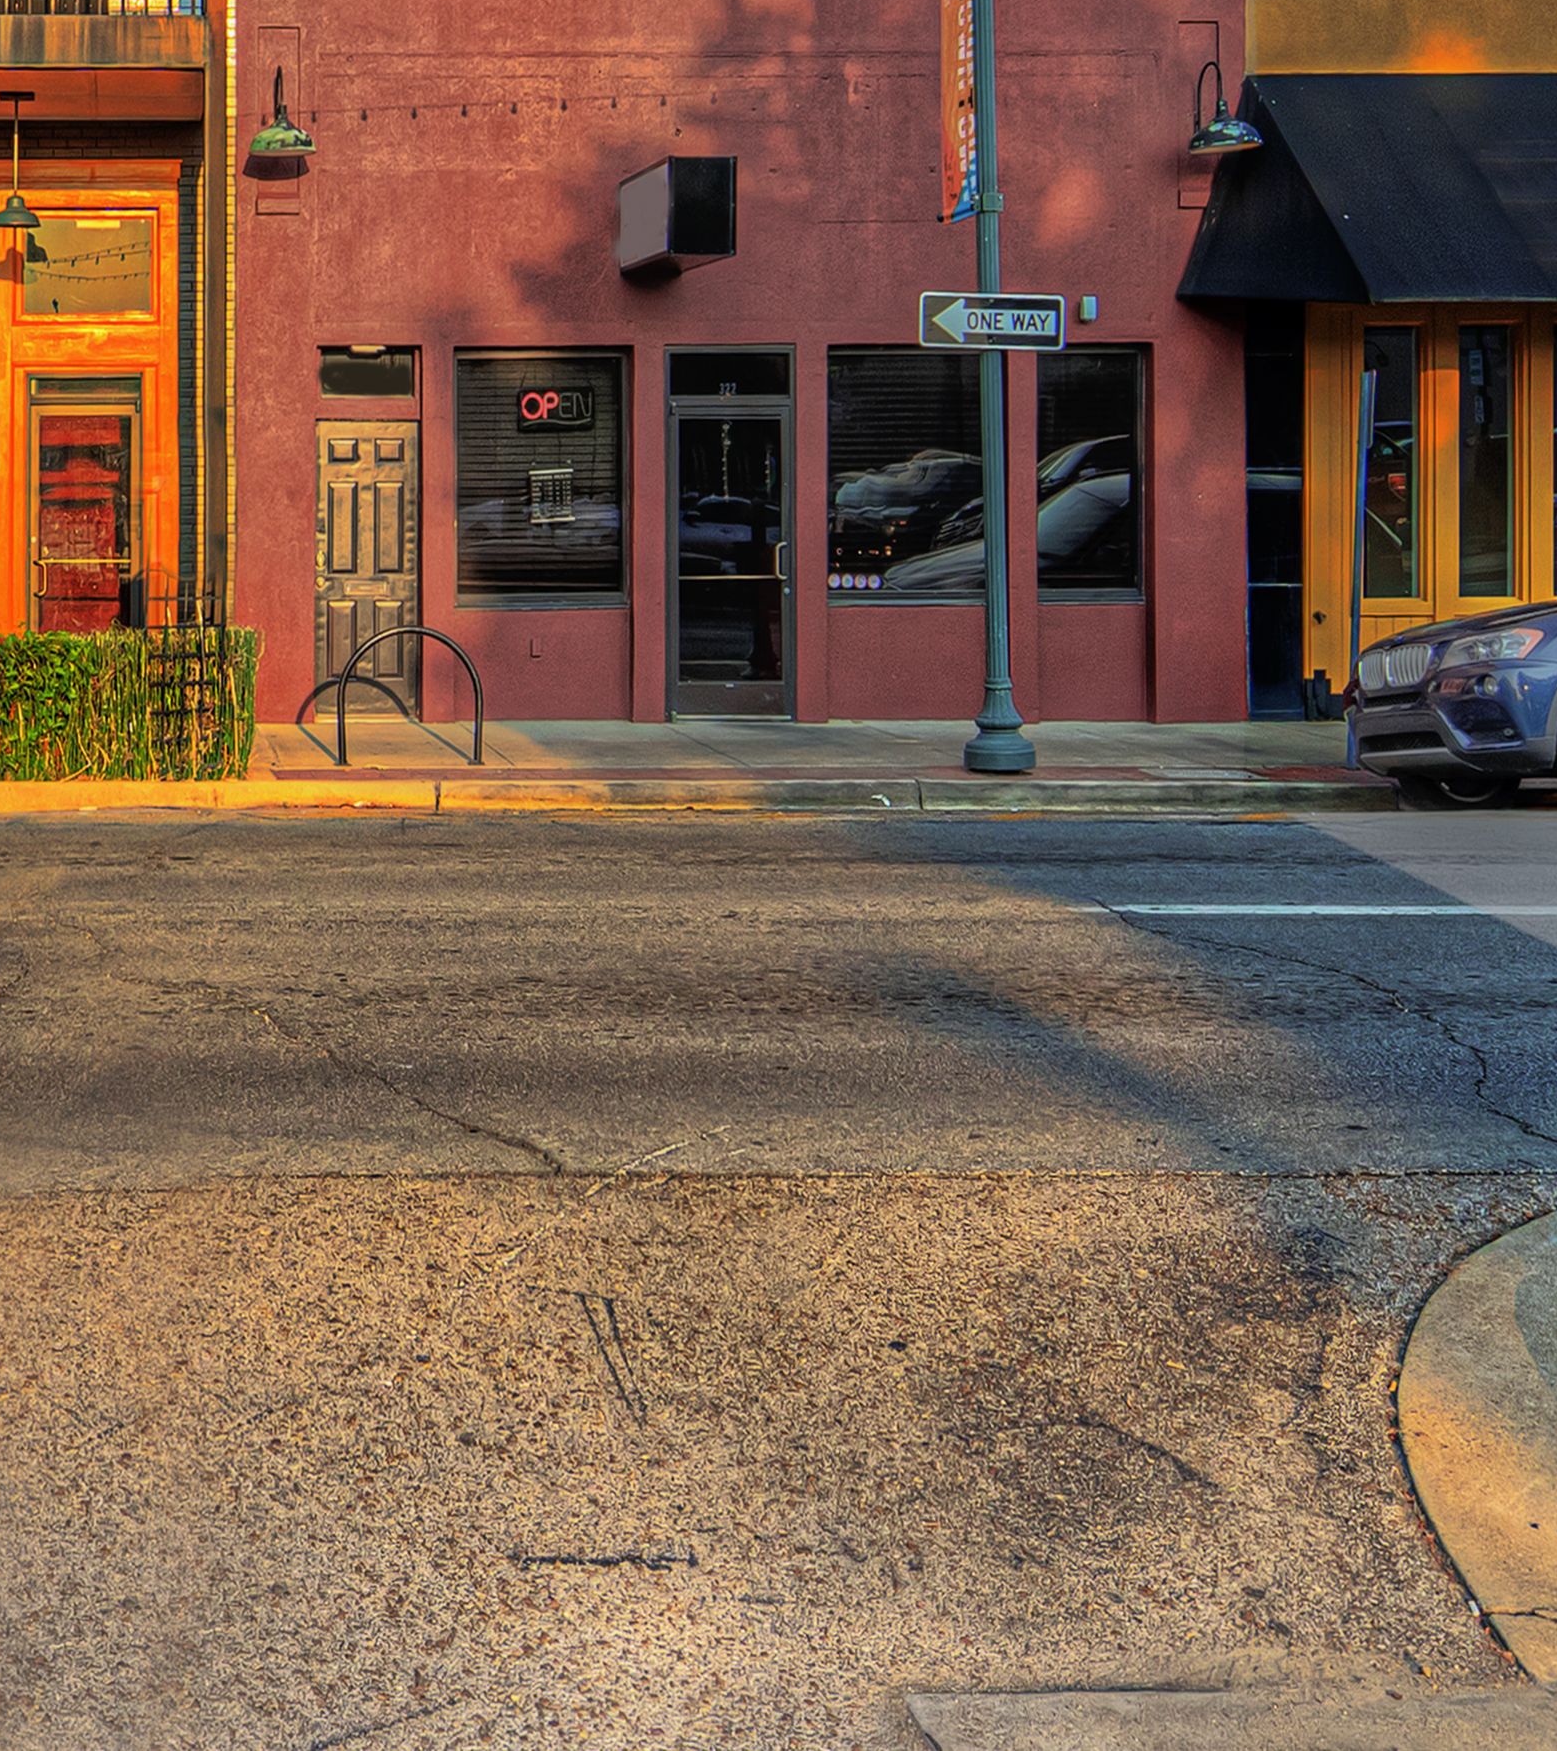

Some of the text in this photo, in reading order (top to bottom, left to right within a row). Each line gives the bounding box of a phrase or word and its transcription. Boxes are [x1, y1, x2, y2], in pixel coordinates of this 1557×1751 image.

[967, 311, 1051, 332] ONE WAY
[719, 382, 737, 395] 322
[521, 391, 593, 420] OPEN
